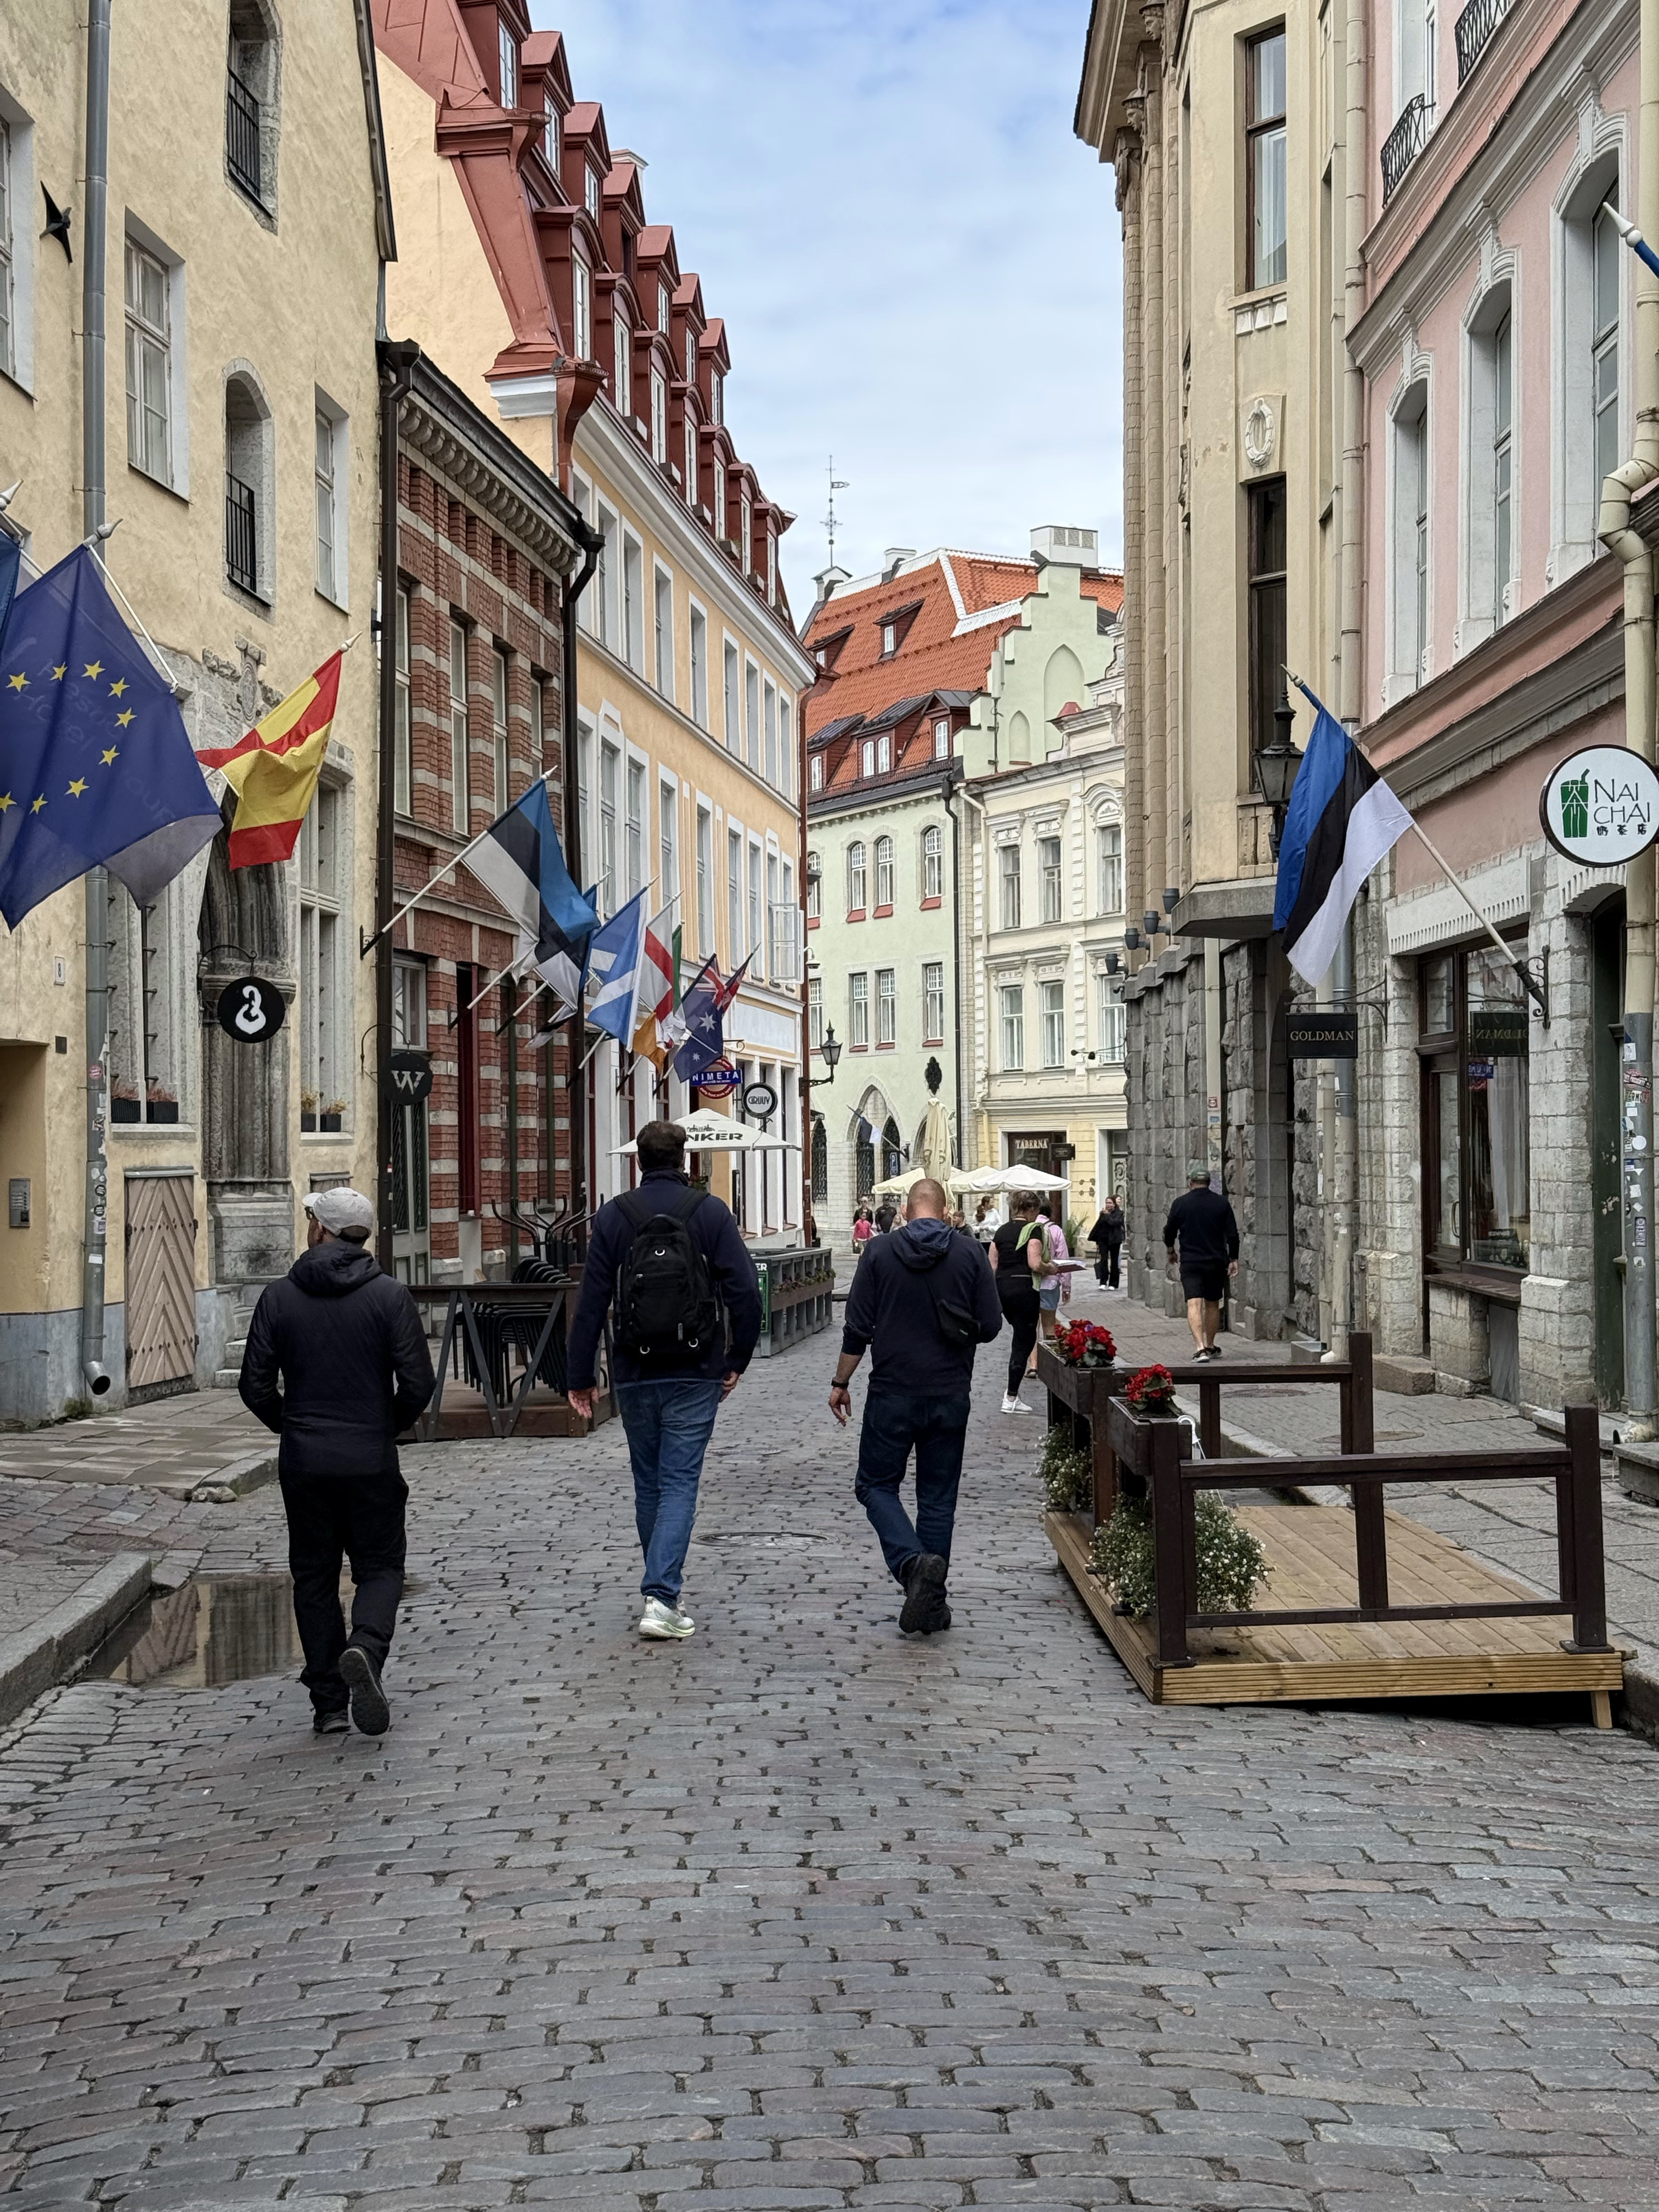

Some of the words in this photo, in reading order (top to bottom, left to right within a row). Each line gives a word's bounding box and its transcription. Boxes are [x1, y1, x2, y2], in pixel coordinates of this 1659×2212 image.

[1594, 778, 1639, 803] NAI
[1593, 802, 1651, 824] CHAI
[58, 962, 61, 978] 8
[1290, 1030, 1355, 1042] GOLDMAN
[391, 1070, 426, 1095] W
[692, 1071, 740, 1081] NIMETA
[686, 1133, 743, 1142] NKER
[1015, 1138, 1048, 1149] TABERNA
